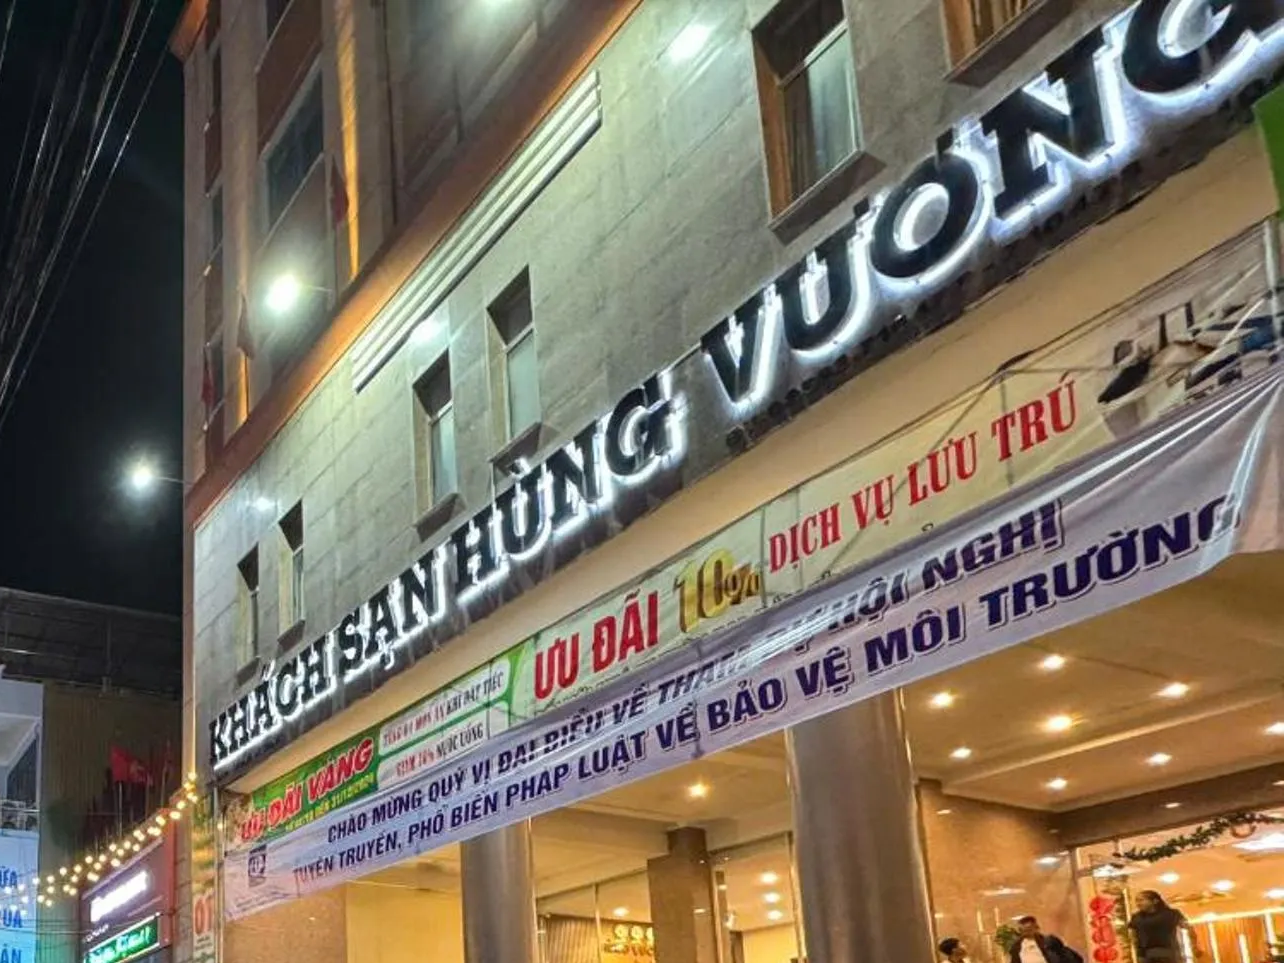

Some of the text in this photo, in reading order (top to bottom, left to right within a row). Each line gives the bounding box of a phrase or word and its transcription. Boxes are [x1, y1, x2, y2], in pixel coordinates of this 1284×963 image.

[209, 633, 336, 769] KHÁCH
[338, 546, 446, 683] SẠN
[452, 371, 683, 603] HÙNG
[328, 810, 368, 843] CHÀO
[372, 789, 422, 825] MỪNG
[428, 766, 467, 803] QUÝ
[472, 757, 491, 785] VỊ
[922, 497, 1064, 591] NGHỊ
[534, 632, 580, 700] ƯU
[592, 588, 659, 673] ĐÃI
[673, 548, 761, 634] 10%
[769, 503, 841, 574] DỊCH
[852, 474, 895, 530] VỤ
[906, 430, 980, 507] LƯU
[991, 372, 1079, 464] TRÚ
[307, 738, 374, 804] VÀNG
[408, 804, 445, 844] PHỔ
[578, 732, 646, 780] LUẬT
[655, 701, 697, 750] VỀ
[707, 678, 784, 733] BẢO
[795, 646, 851, 696] VỆ
[863, 606, 962, 674] MÔI
